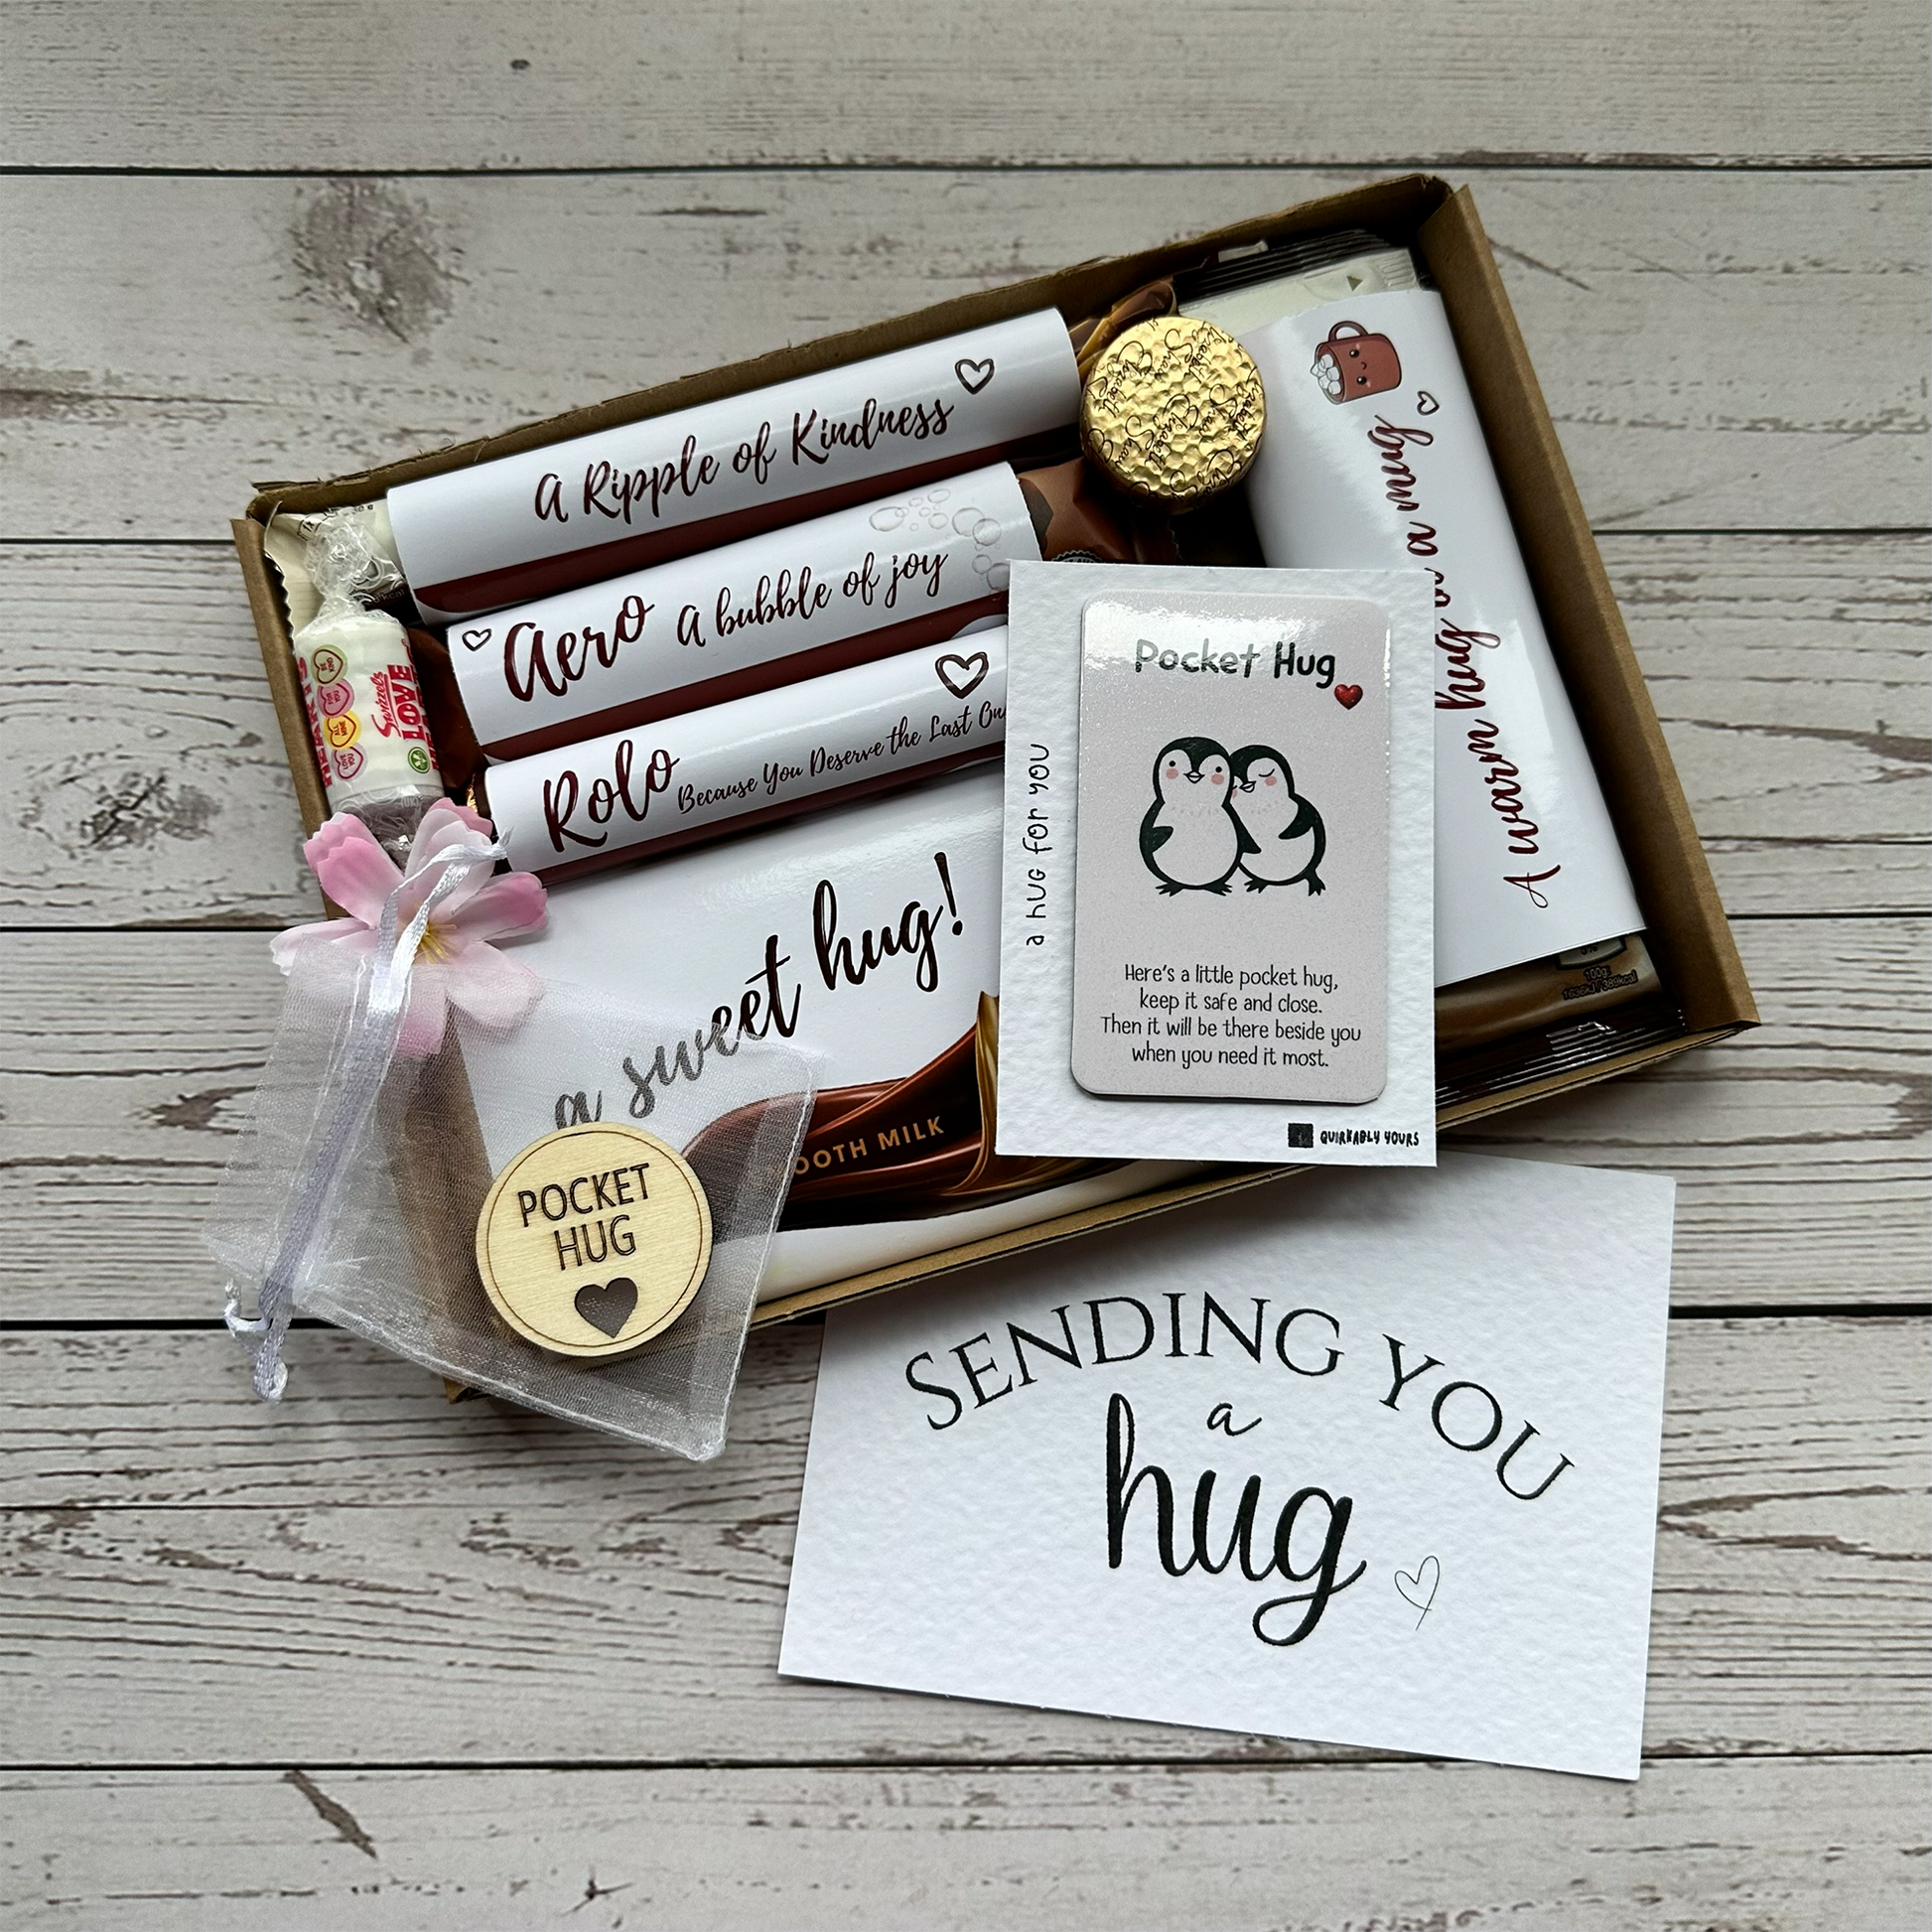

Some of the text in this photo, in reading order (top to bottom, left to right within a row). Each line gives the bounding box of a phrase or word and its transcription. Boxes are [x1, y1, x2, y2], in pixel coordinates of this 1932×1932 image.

[535, 398, 954, 524] A Ripple of Kindness
[1367, 414, 1434, 511] mug
[1406, 521, 1439, 556] a
[503, 552, 948, 702] Aero A bubble of joy
[1135, 637, 1335, 689] Pocket Hug
[1435, 618, 1501, 710] hug
[369, 671, 402, 738] Swizzels
[387, 664, 426, 740] LOVE
[543, 700, 1006, 852] Rolo Because You Deserve the Last On
[1467, 719, 1539, 855] warm
[1503, 864, 1561, 908] A
[1025, 934, 1045, 946] a
[554, 852, 963, 1130] a sweet hug!
[1125, 964, 1338, 994] Here's a little pocket hug,
[1140, 987, 1322, 1015] keep it safe and close.
[1100, 1012, 1361, 1047] Then it will be there beside you
[1132, 1040, 1328, 1070] when you need it most.
[793, 1116, 944, 1175] OOTH MILK
[1320, 1128, 1420, 1148] QUIRKABLY YOURS
[518, 1163, 649, 1227] POCKET
[554, 1214, 636, 1271] HUG
[904, 1291, 1575, 1500] SENDING YOU
[1206, 1403, 1262, 1436] a
[1106, 1393, 1367, 1646] hug
